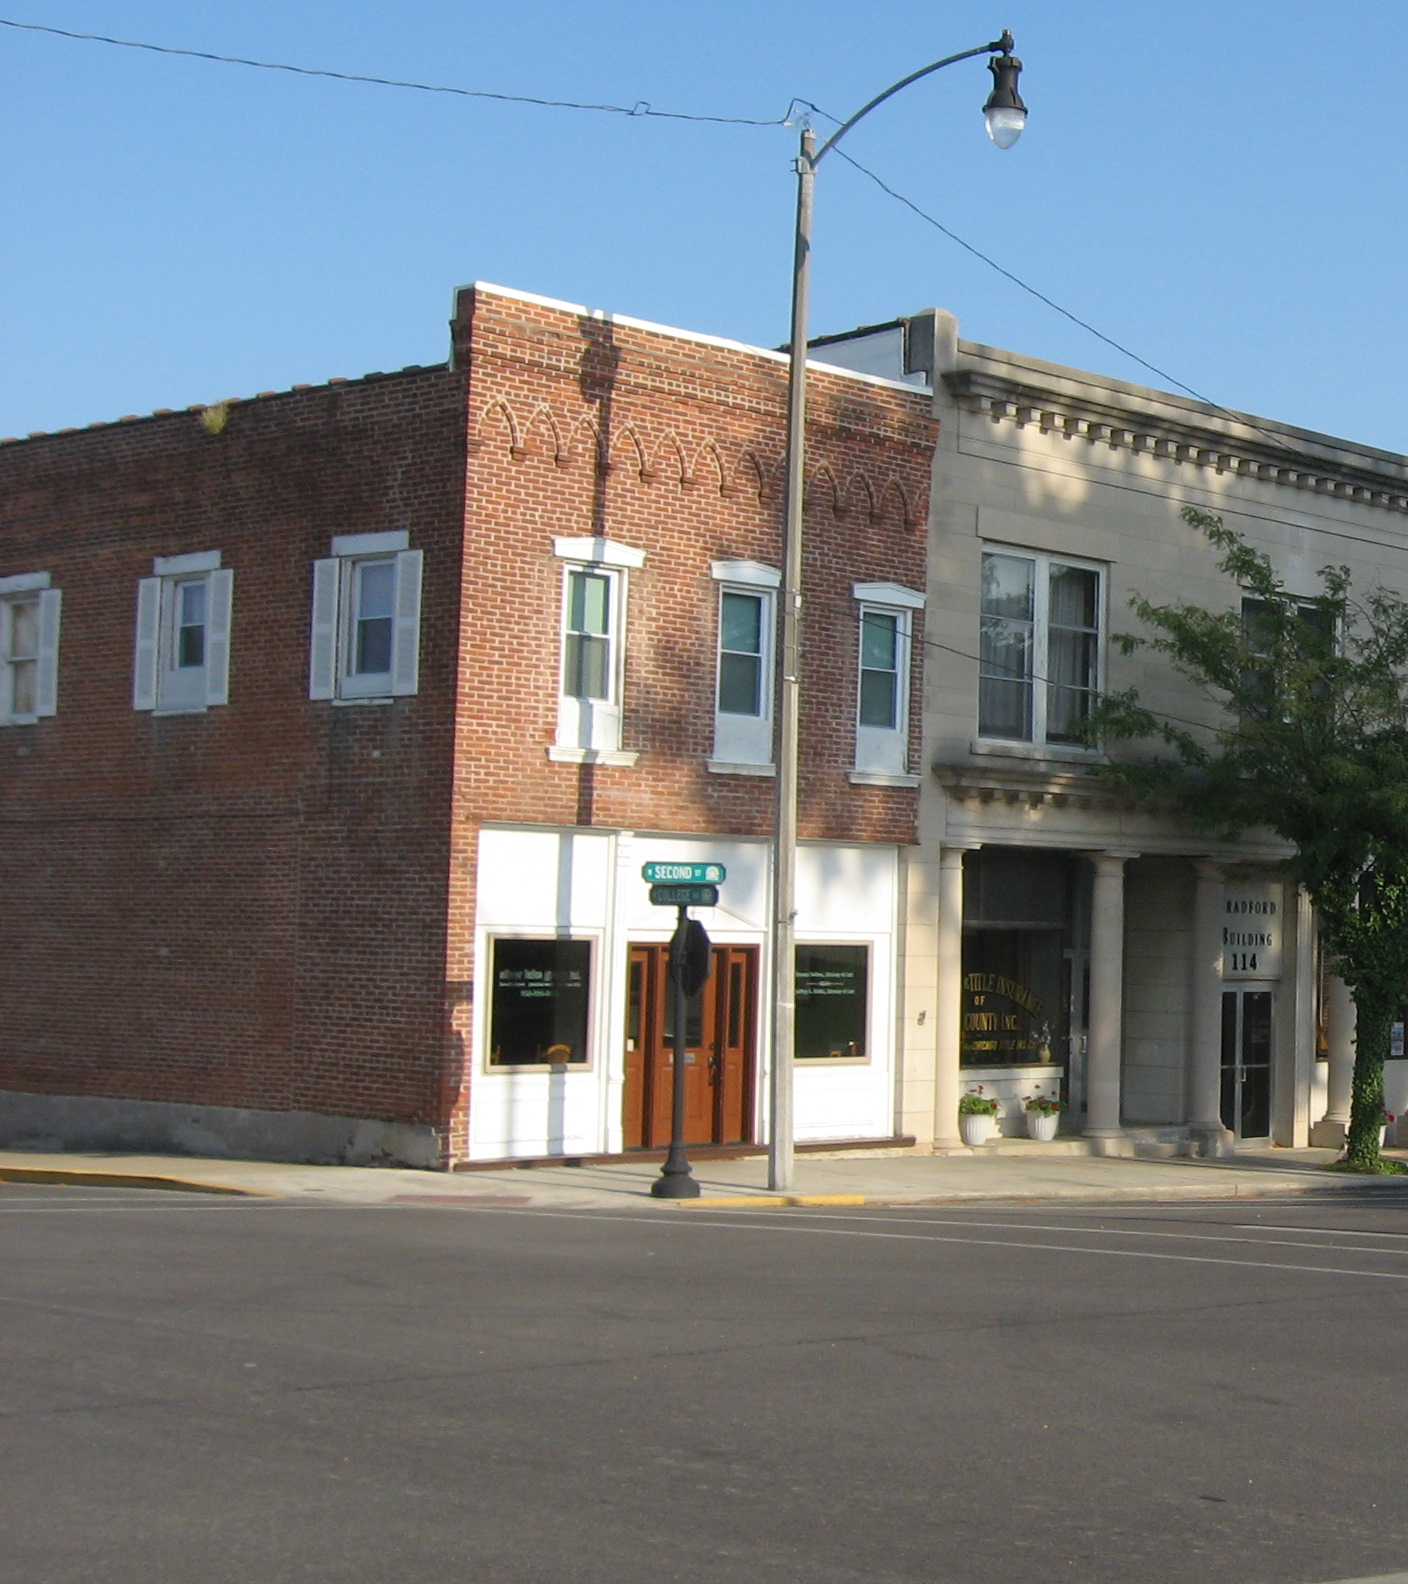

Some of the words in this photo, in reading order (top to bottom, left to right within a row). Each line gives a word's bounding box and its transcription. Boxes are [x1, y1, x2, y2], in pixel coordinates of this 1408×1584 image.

[654, 866, 692, 879] SECOND
[658, 889, 691, 902] COLLEGE
[1226, 901, 1276, 915] RADFORD
[1223, 927, 1273, 946] BUILDING
[1232, 953, 1257, 971] 114
[968, 973, 996, 992] TITLE
[995, 976, 1045, 1019] INSURANCE
[974, 995, 986, 1006] OF
[964, 1012, 997, 1031] COUNTY
